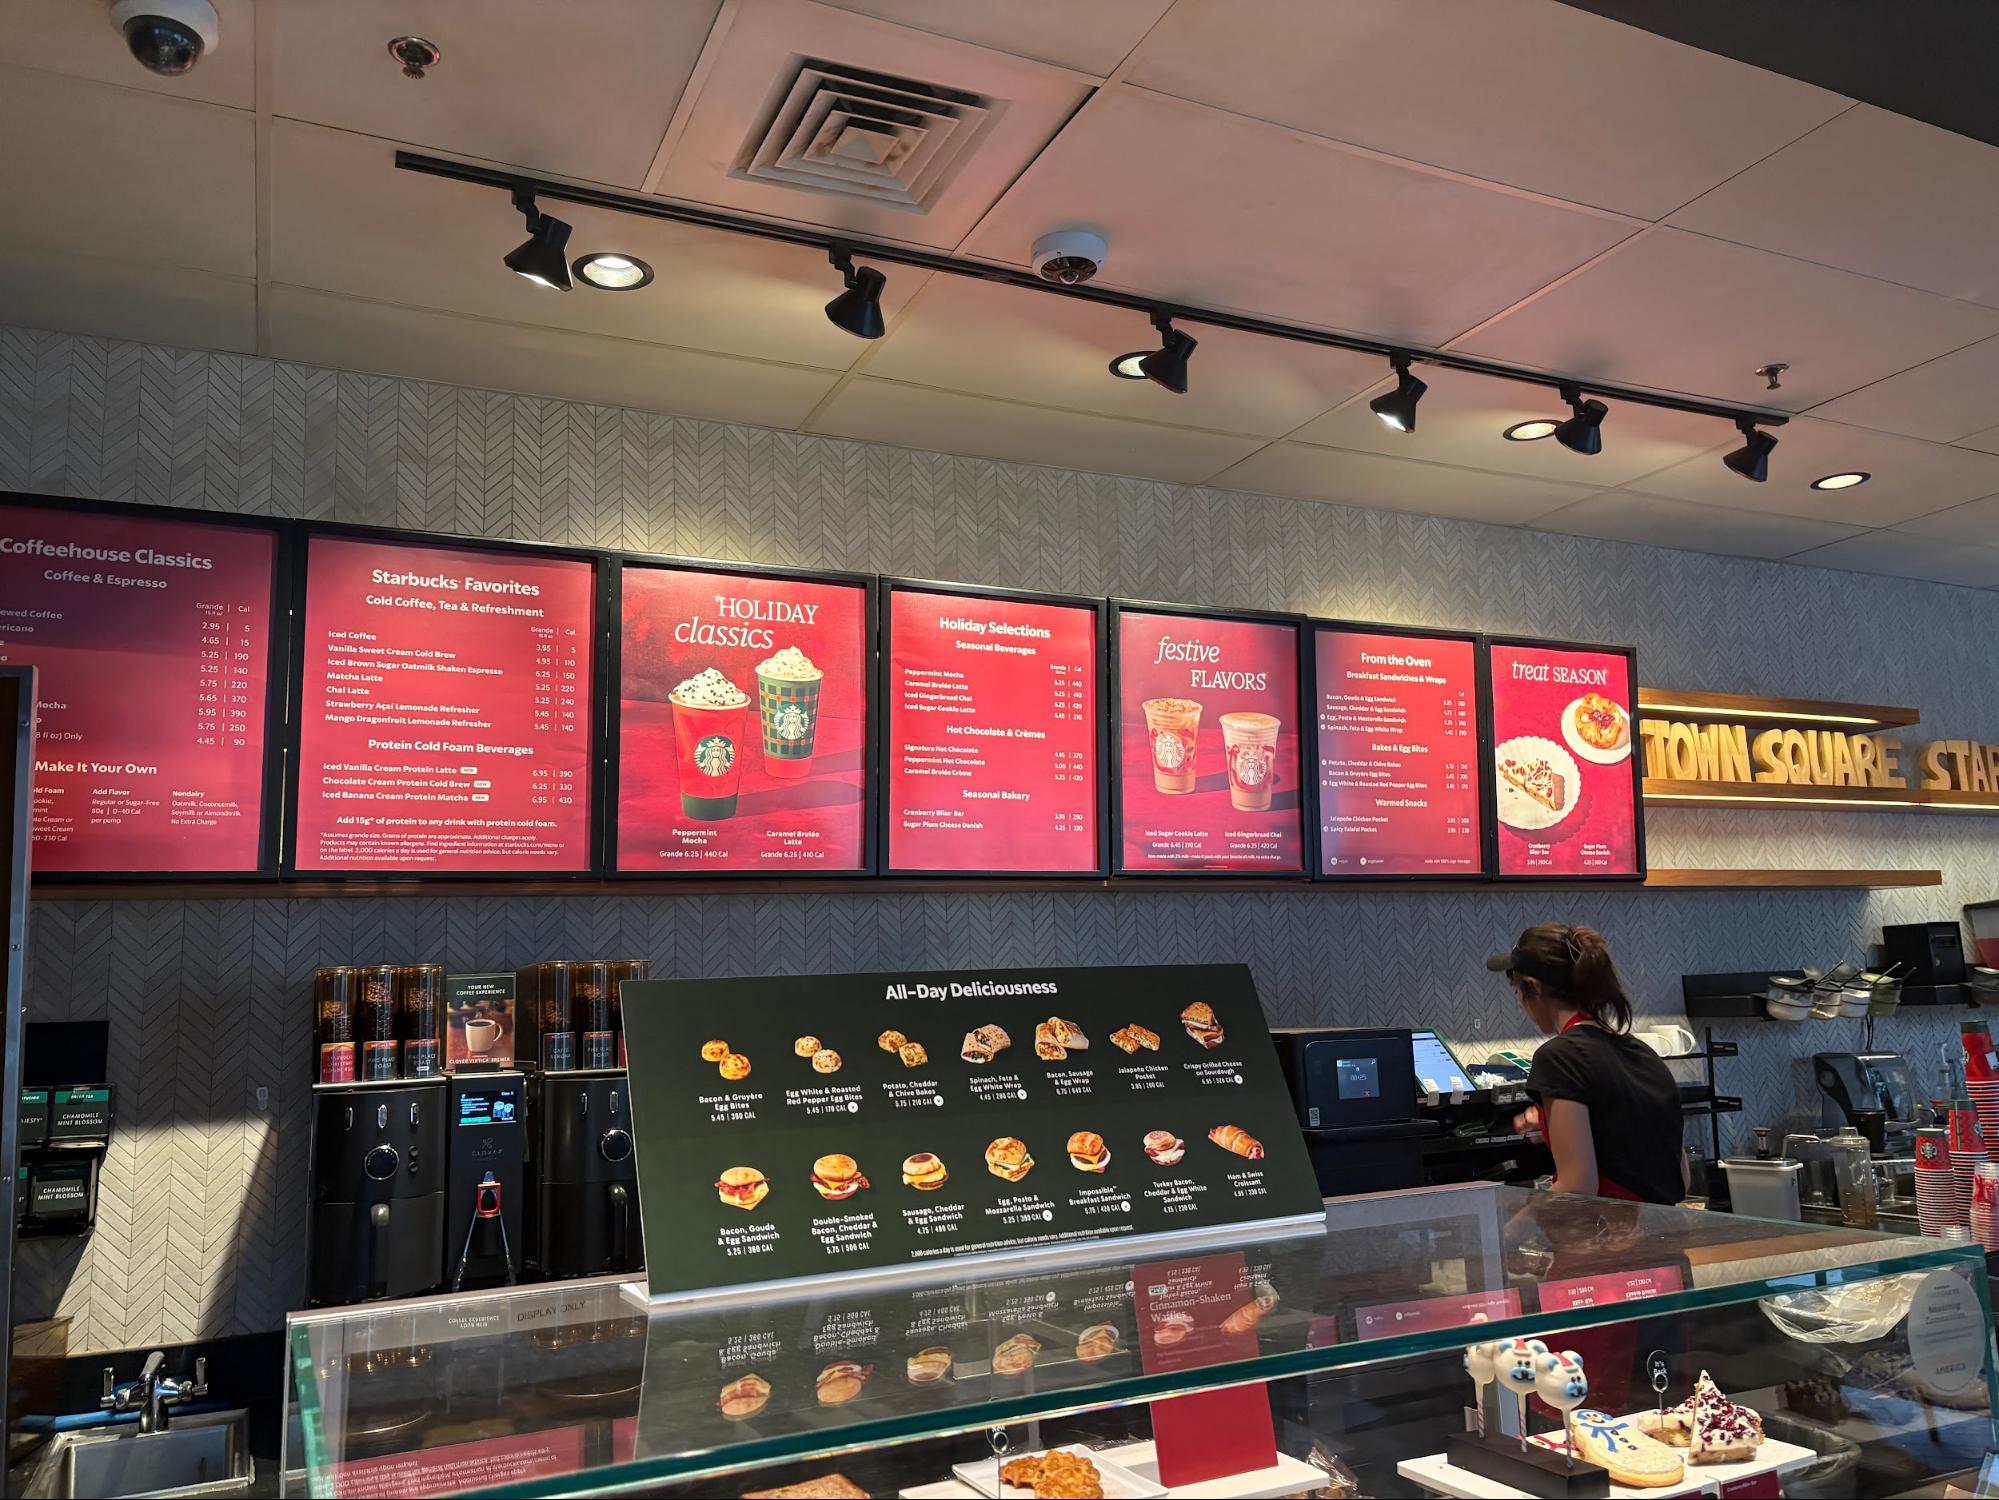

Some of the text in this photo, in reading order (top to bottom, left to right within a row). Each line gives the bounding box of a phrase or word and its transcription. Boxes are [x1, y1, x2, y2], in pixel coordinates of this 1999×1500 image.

[0, 538, 213, 570] Coffeehouse Classics
[44, 570, 168, 589] Coffee & Espresso
[372, 569, 540, 596] Starbucks Favorites
[196, 602, 224, 611] Grande
[366, 595, 544, 617] Cold Coffee, Tea & Refreshment
[718, 597, 818, 624] HOLIDAY
[202, 622, 220, 630] 2.95
[674, 616, 774, 649] classics
[940, 617, 1050, 638] Holiday Selections
[328, 631, 377, 640] Iced Coffee
[328, 645, 456, 658] Vanilla Sweet Cream Cold Brew
[956, 640, 1036, 656] Seasonal Beverages
[1154, 636, 1220, 664] festive
[201, 651, 249, 661] 5.25 190
[1361, 653, 1431, 667] From the Oven
[328, 658, 503, 675] Iced Brown Sugar Oatmilk Shaken Espresso
[1512, 660, 1607, 686] treat SEASON
[327, 672, 383, 682] Matcha Latte
[1191, 669, 1266, 690] FLAVORS
[1347, 671, 1378, 680] Breakfast
[1380, 673, 1418, 683] Sandwiches
[1426, 676, 1446, 685] Wraps
[200, 680, 248, 689] 5.75 220
[326, 686, 369, 695] Chai Latte
[326, 700, 480, 714] Strawberry Açaí Lemonade Refresher
[325, 714, 492, 728] Mango Dragonfruit Lemonade Refresher
[947, 726, 1045, 739] Hot Chocolate & Crèmes
[369, 740, 534, 755] Protein Cold Foam Beverages
[1393, 744, 1398, 752] &
[1399, 744, 1410, 754] Egg
[1412, 745, 1428, 753] Bites
[1641, 719, 1751, 782] TOWN
[1752, 728, 1906, 789] SQUARE
[35, 761, 157, 775] Make It Your Own
[344, 763, 372, 772] Vanilla
[374, 764, 401, 772] Cream
[403, 765, 432, 774] Protein
[434, 766, 457, 774] Latte
[323, 777, 470, 788] Chocolate Cream Protein Cold Brew
[93, 788, 130, 796] Add Flavor
[173, 790, 204, 798] Nondairy
[963, 790, 1030, 801] Seasonal Bakery
[1376, 798, 1428, 807] Warmed Snacks
[672, 829, 717, 838] Peppermint
[767, 830, 820, 838] Caramel Brulée
[660, 850, 682, 858] Grande
[886, 981, 1058, 1001] All-Day Deliciousness
[731, 1093, 762, 1101] Gruyère
[715, 1103, 728, 1111] Egg
[57, 1118, 72, 1126] MINT
[54, 1191, 83, 1199] BLOSSOM
[902, 1203, 964, 1217] Sausage, Cheddar
[813, 1213, 874, 1226] Double-Smoked
[915, 1216, 928, 1225] Egg
[929, 1212, 962, 1222] Sandwich
[720, 1224, 775, 1236] Bacon, Gouda
[812, 1226, 837, 1235] Bacon,
[839, 1223, 870, 1232] Cheddar
[726, 1236, 740, 1246] Egg
[742, 1232, 779, 1242] Sandwich
[821, 1231, 872, 1244] Egg Sandwich
[1149, 1293, 1231, 1311] Cinnamon-Shaken
[518, 1301, 586, 1321] DISPLAY ONLY
